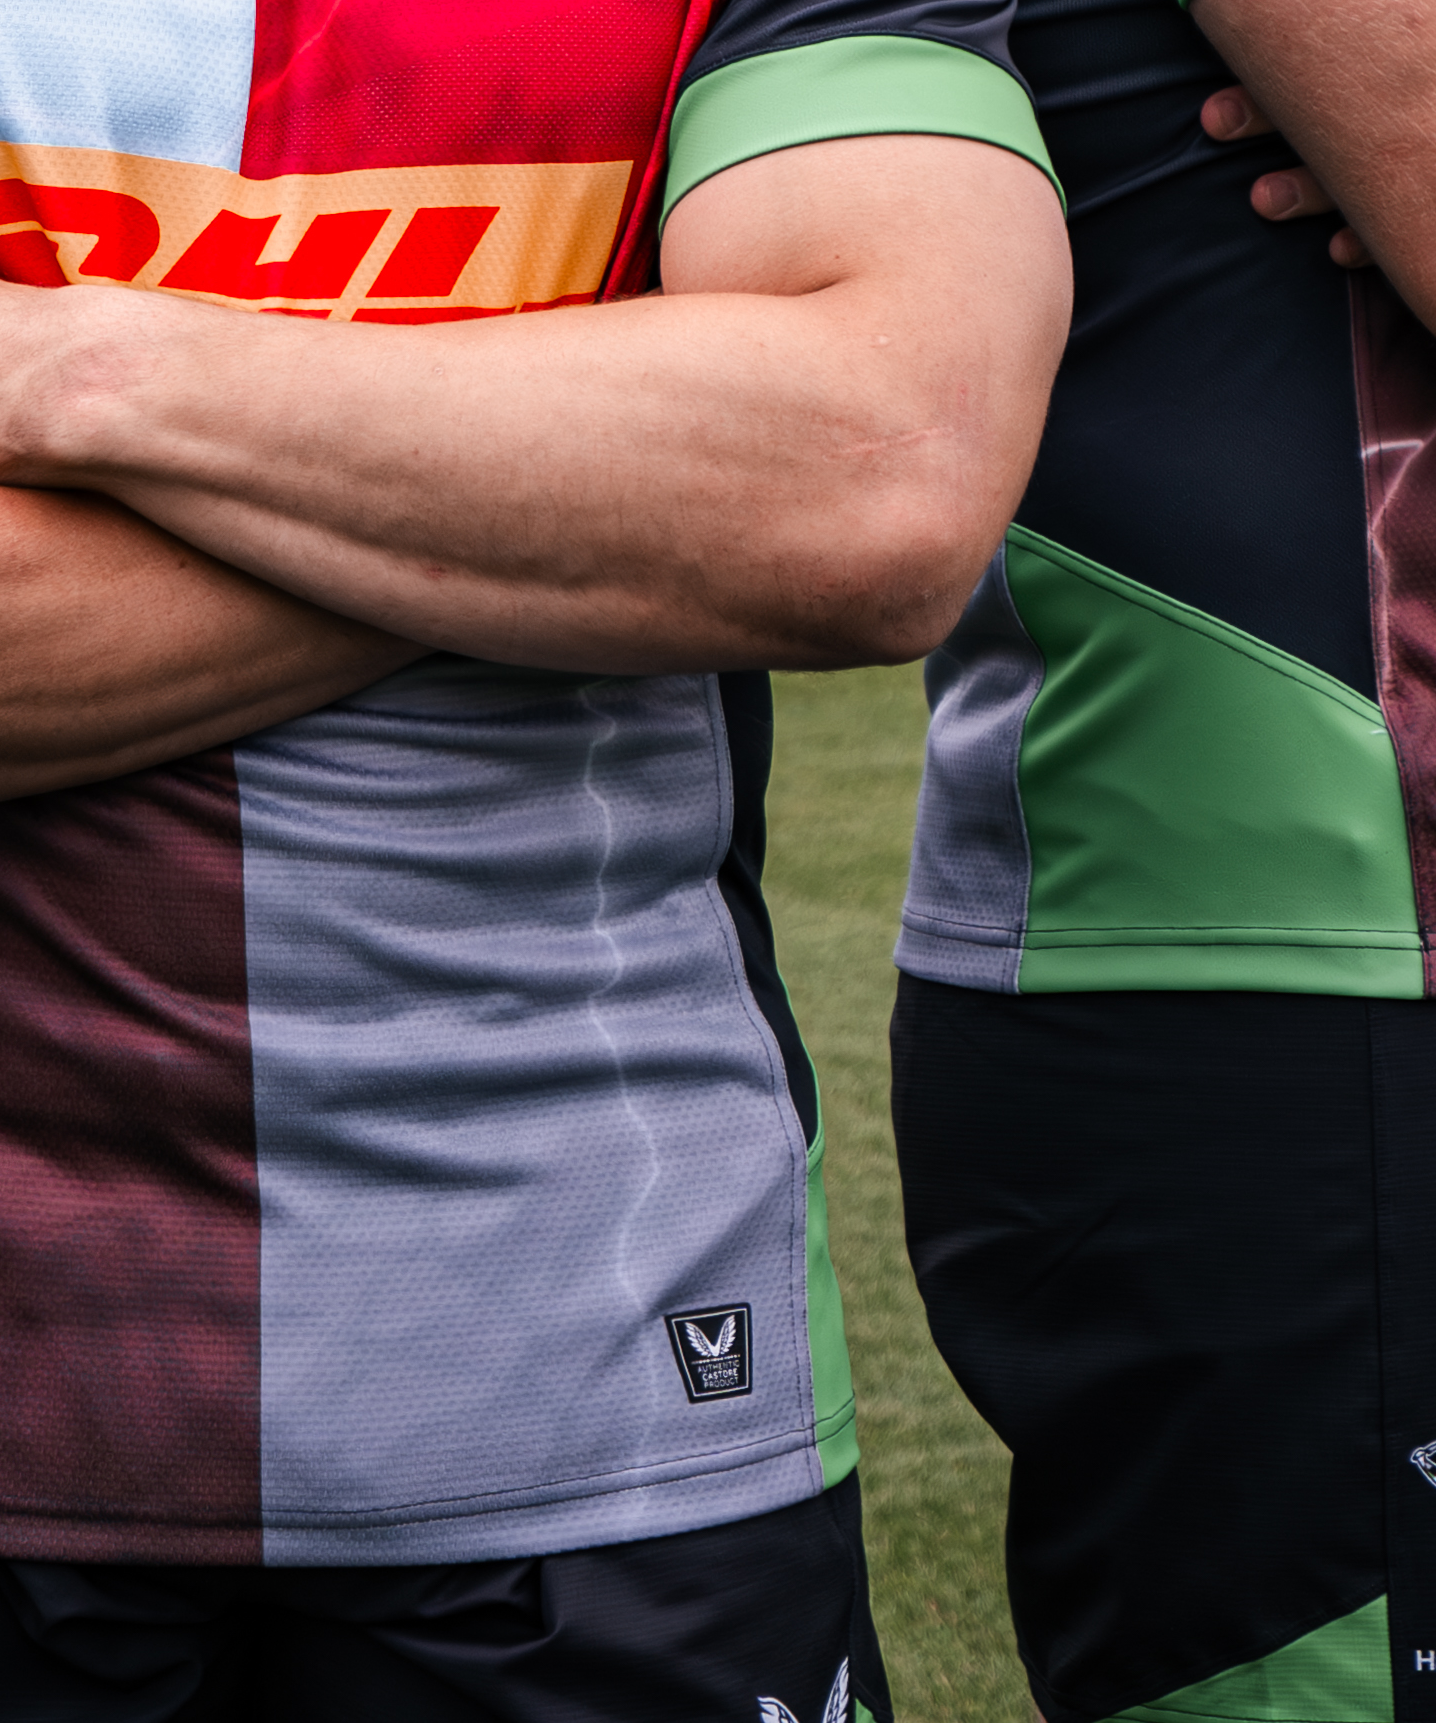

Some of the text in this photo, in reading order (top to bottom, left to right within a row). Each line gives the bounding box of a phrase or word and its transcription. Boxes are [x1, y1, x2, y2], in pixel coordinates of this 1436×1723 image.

[697, 1359, 740, 1373] AUTHENTIC
[702, 1368, 739, 1381] CASTORE
[704, 1377, 739, 1389] PRODUCT
